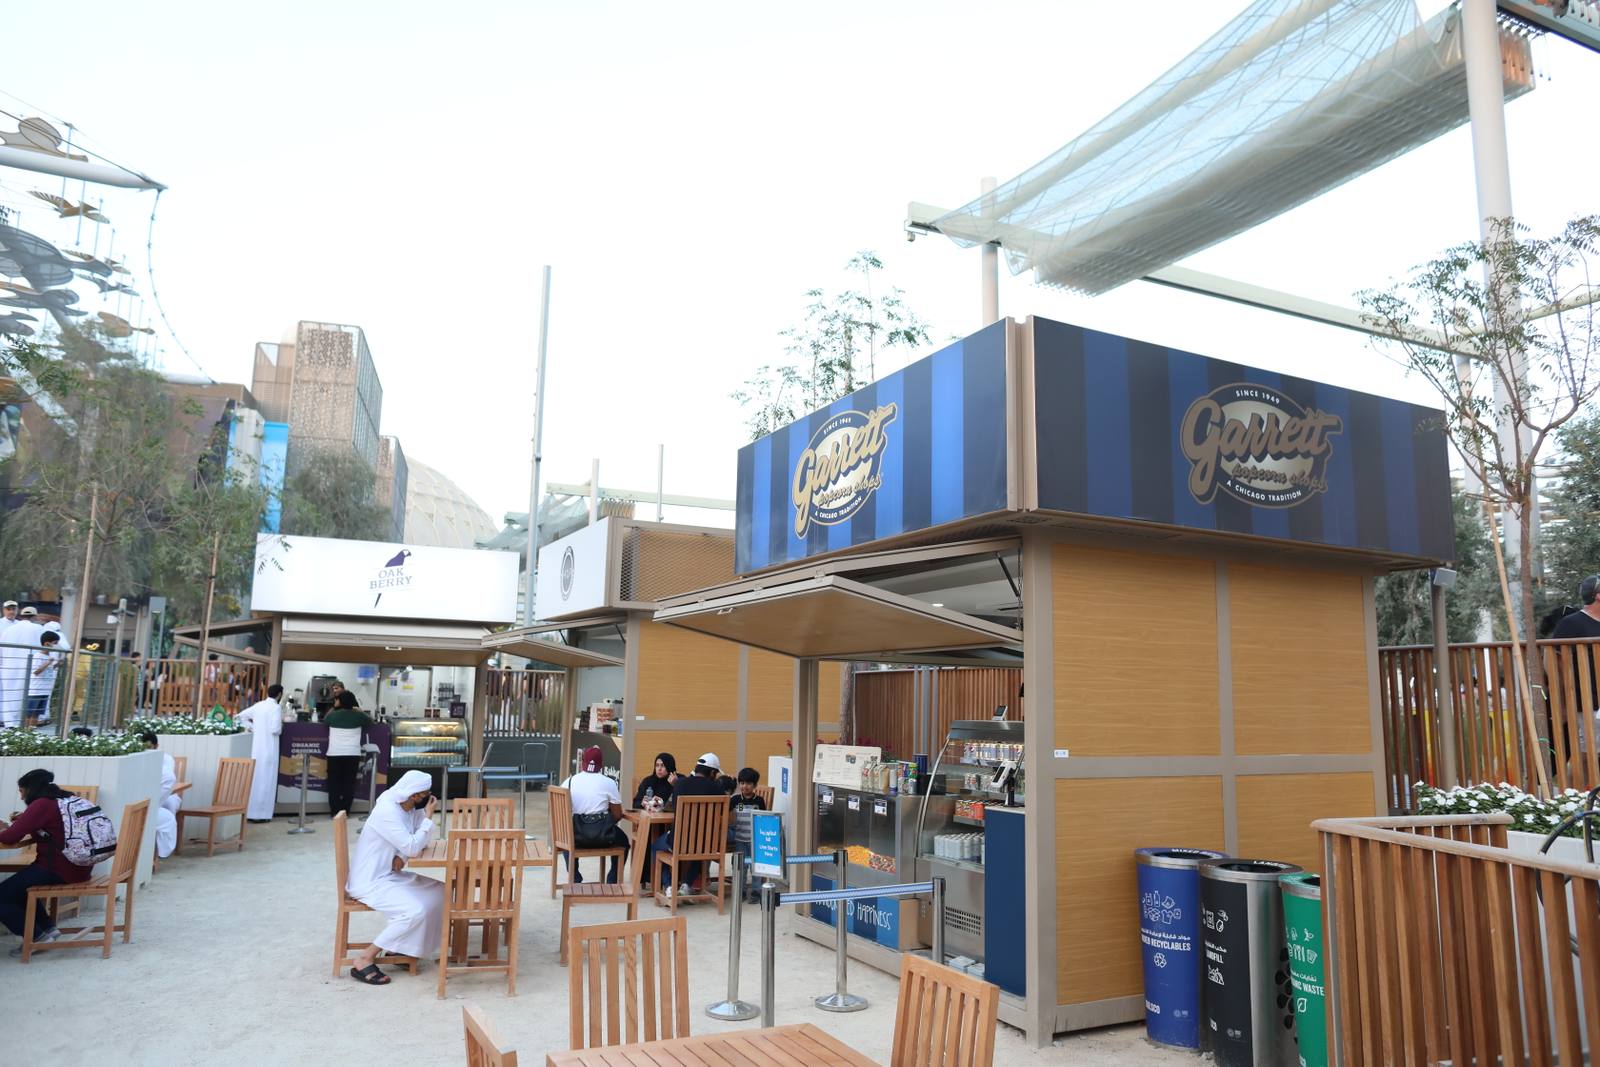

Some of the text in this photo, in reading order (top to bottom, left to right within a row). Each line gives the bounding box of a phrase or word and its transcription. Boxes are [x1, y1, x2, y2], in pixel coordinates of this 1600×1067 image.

[1235, 389, 1280, 405] SINCE 1949
[823, 419, 838, 435] SINCE
[1181, 398, 1342, 502] Garrett
[793, 402, 897, 538] Garrett
[1226, 479, 1302, 503] A CHICAGO TRADITION
[819, 511, 838, 519] CHICAGO
[839, 496, 862, 516] TRADITION
[378, 567, 404, 579] OAK
[369, 575, 413, 590] BERRY
[291, 742, 321, 750] ORGANIC
[1151, 938, 1191, 952] RECYCLABLES
[1302, 983, 1325, 997] WASTE
